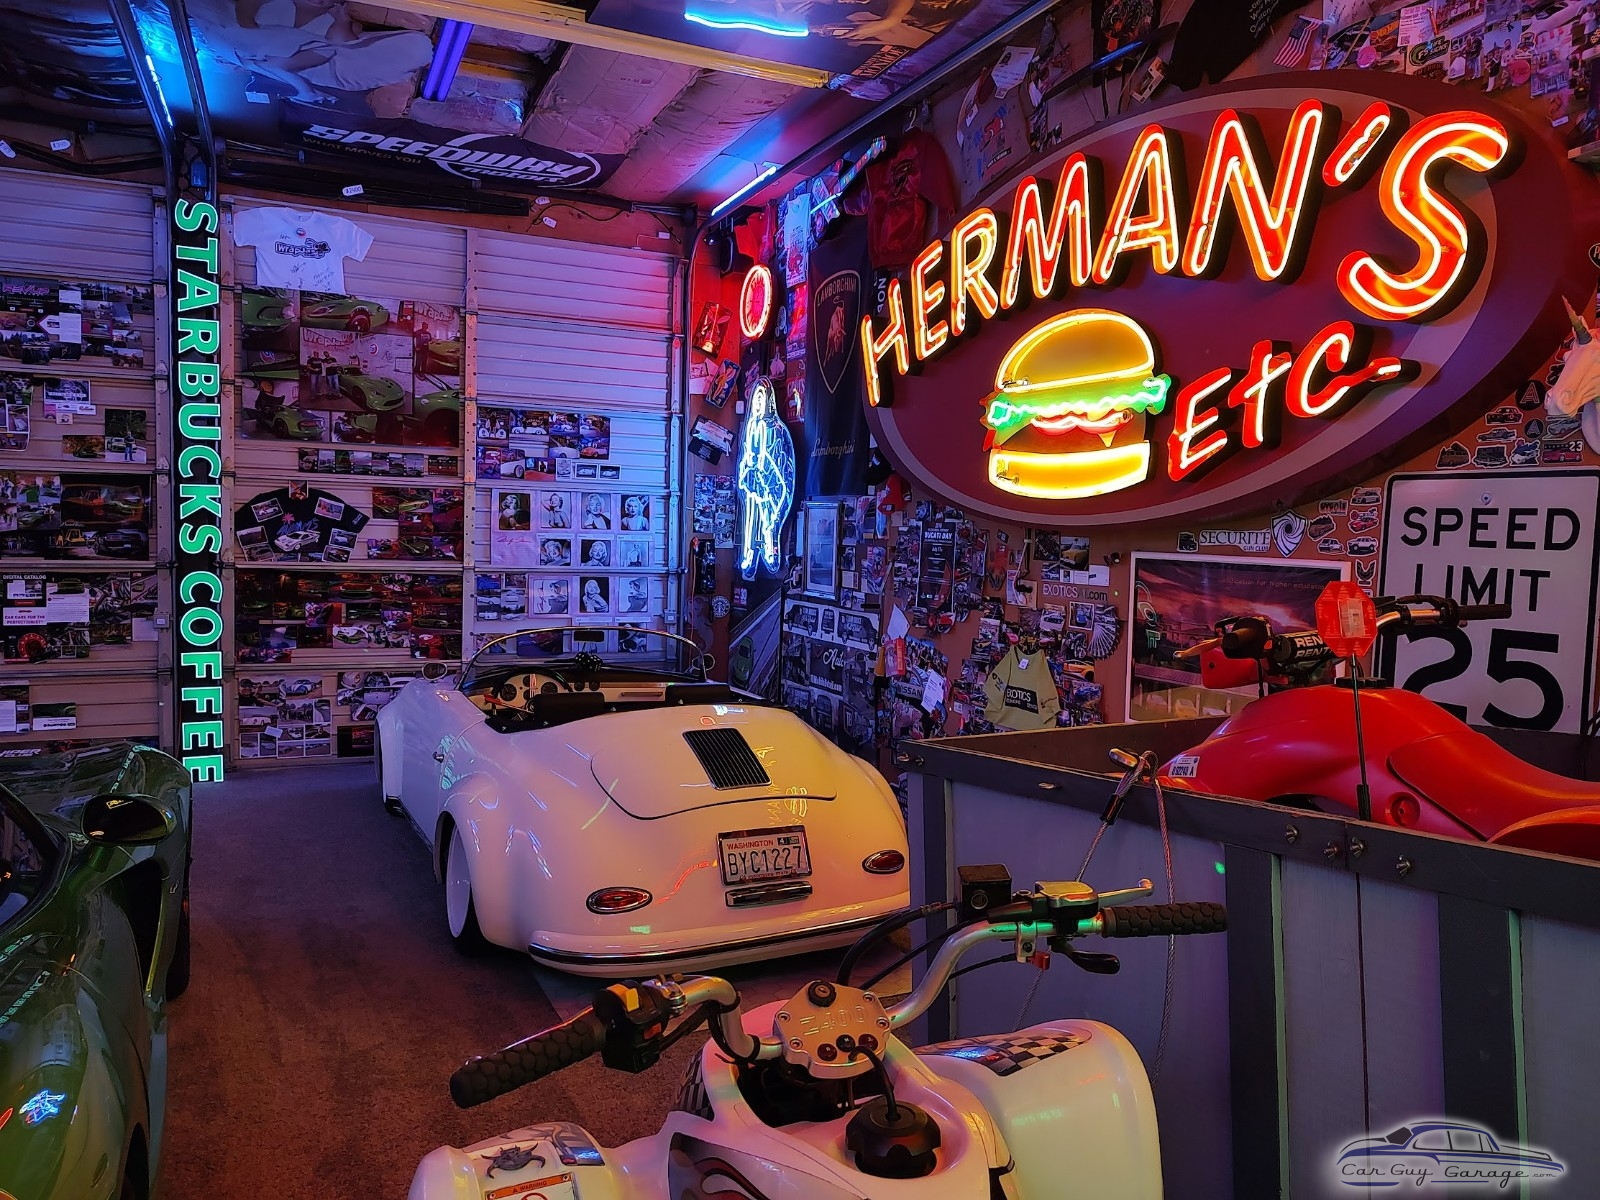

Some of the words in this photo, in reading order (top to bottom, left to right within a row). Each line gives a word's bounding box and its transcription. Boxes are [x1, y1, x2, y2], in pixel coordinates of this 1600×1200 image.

[302, 123, 592, 178] SPEEDWAY
[302, 136, 342, 151] WHAT
[344, 145, 392, 160] MOVES
[395, 154, 422, 165] YOU
[862, 98, 1509, 407] HERMAN'S
[816, 276, 858, 308] LAMBORGHINI
[174, 198, 223, 555] STARBUCKS
[810, 437, 857, 461] Lamborghini
[1569, 440, 1584, 452] 23
[924, 531, 941, 540] DUCATI
[942, 532, 953, 540] DAY
[1400, 506, 1581, 551] SPEED
[1269, 581, 1291, 589] higher
[1414, 563, 1551, 612] LIMIT
[1293, 635, 1324, 648] REN
[1295, 646, 1333, 658] RENT
[179, 570, 225, 783] COFFEE
[1401, 625, 1564, 731] 25
[1006, 688, 1032, 702] EXOTICS
[726, 840, 774, 851] WASHINGTON
[727, 845, 802, 877] BYC1227
[519, 1180, 548, 1193] WARNING
